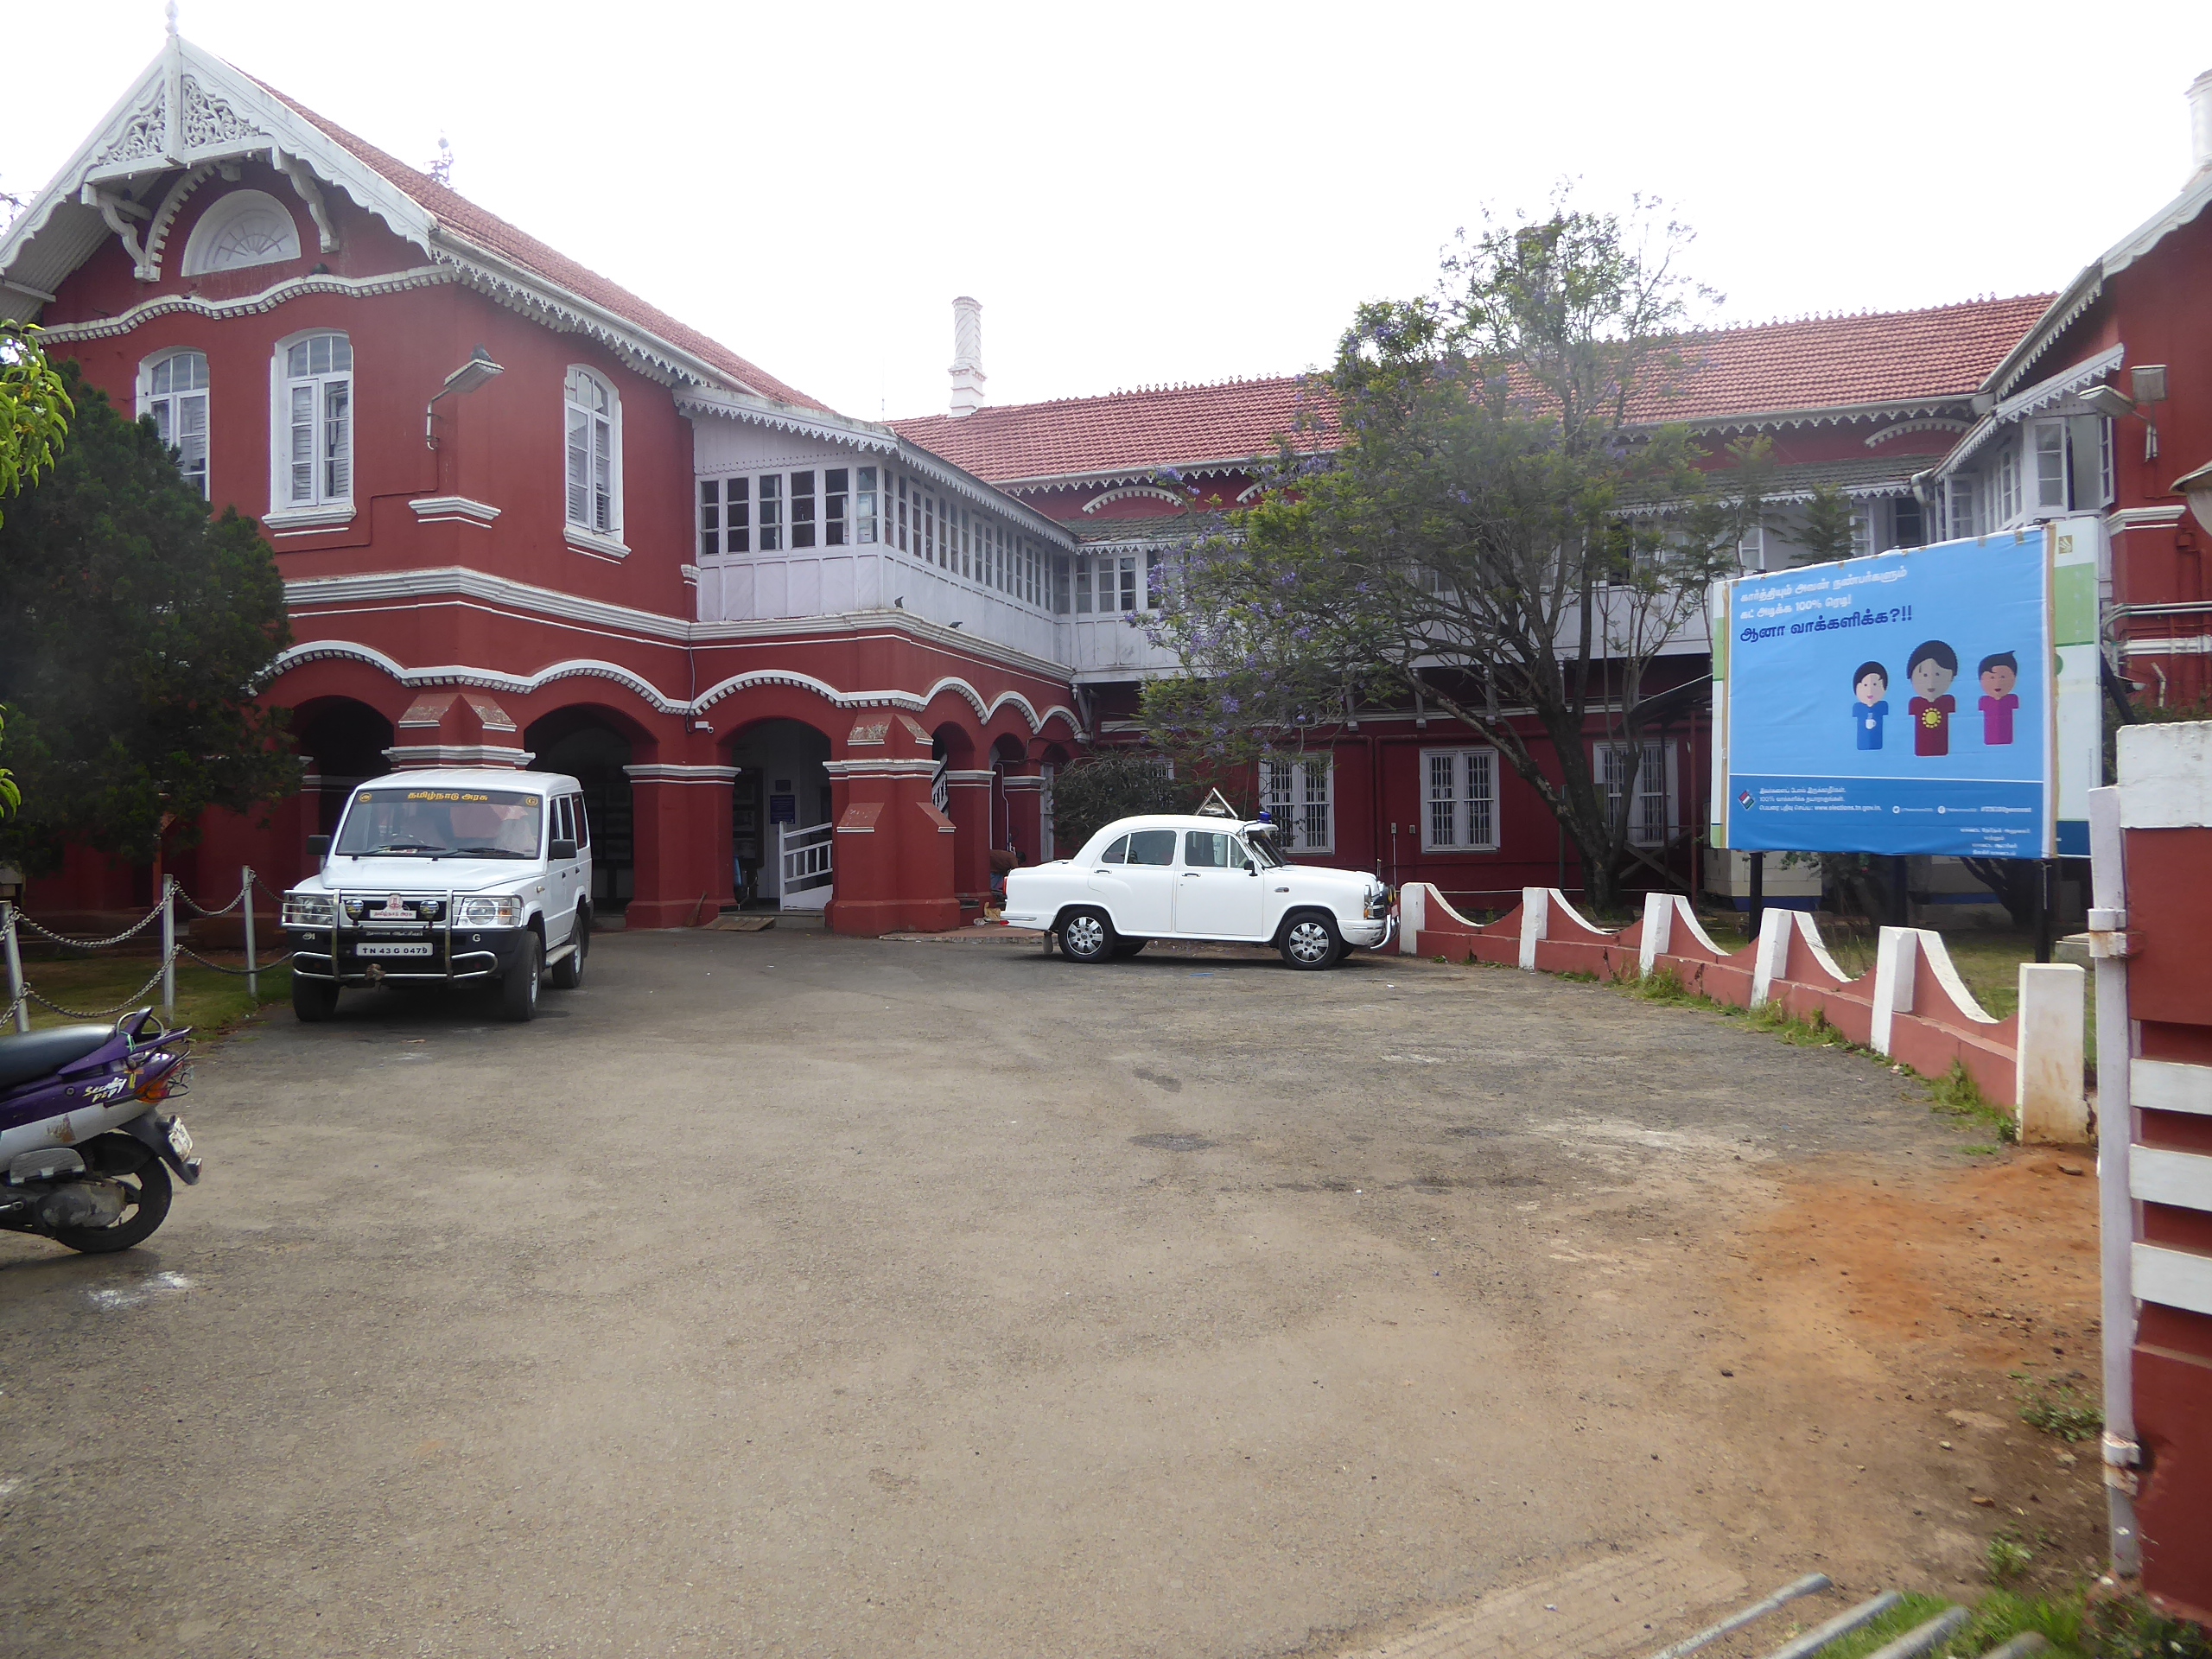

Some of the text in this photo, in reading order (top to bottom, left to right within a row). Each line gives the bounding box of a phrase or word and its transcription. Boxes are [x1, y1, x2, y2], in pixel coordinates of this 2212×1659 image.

[1796, 600, 1821, 612] 100%
[1740, 604, 1913, 643] ஆனா வாக்களிக்க?!!
[407, 791, 489, 802] தமிழ்நாடு அரசு
[473, 933, 481, 943] G
